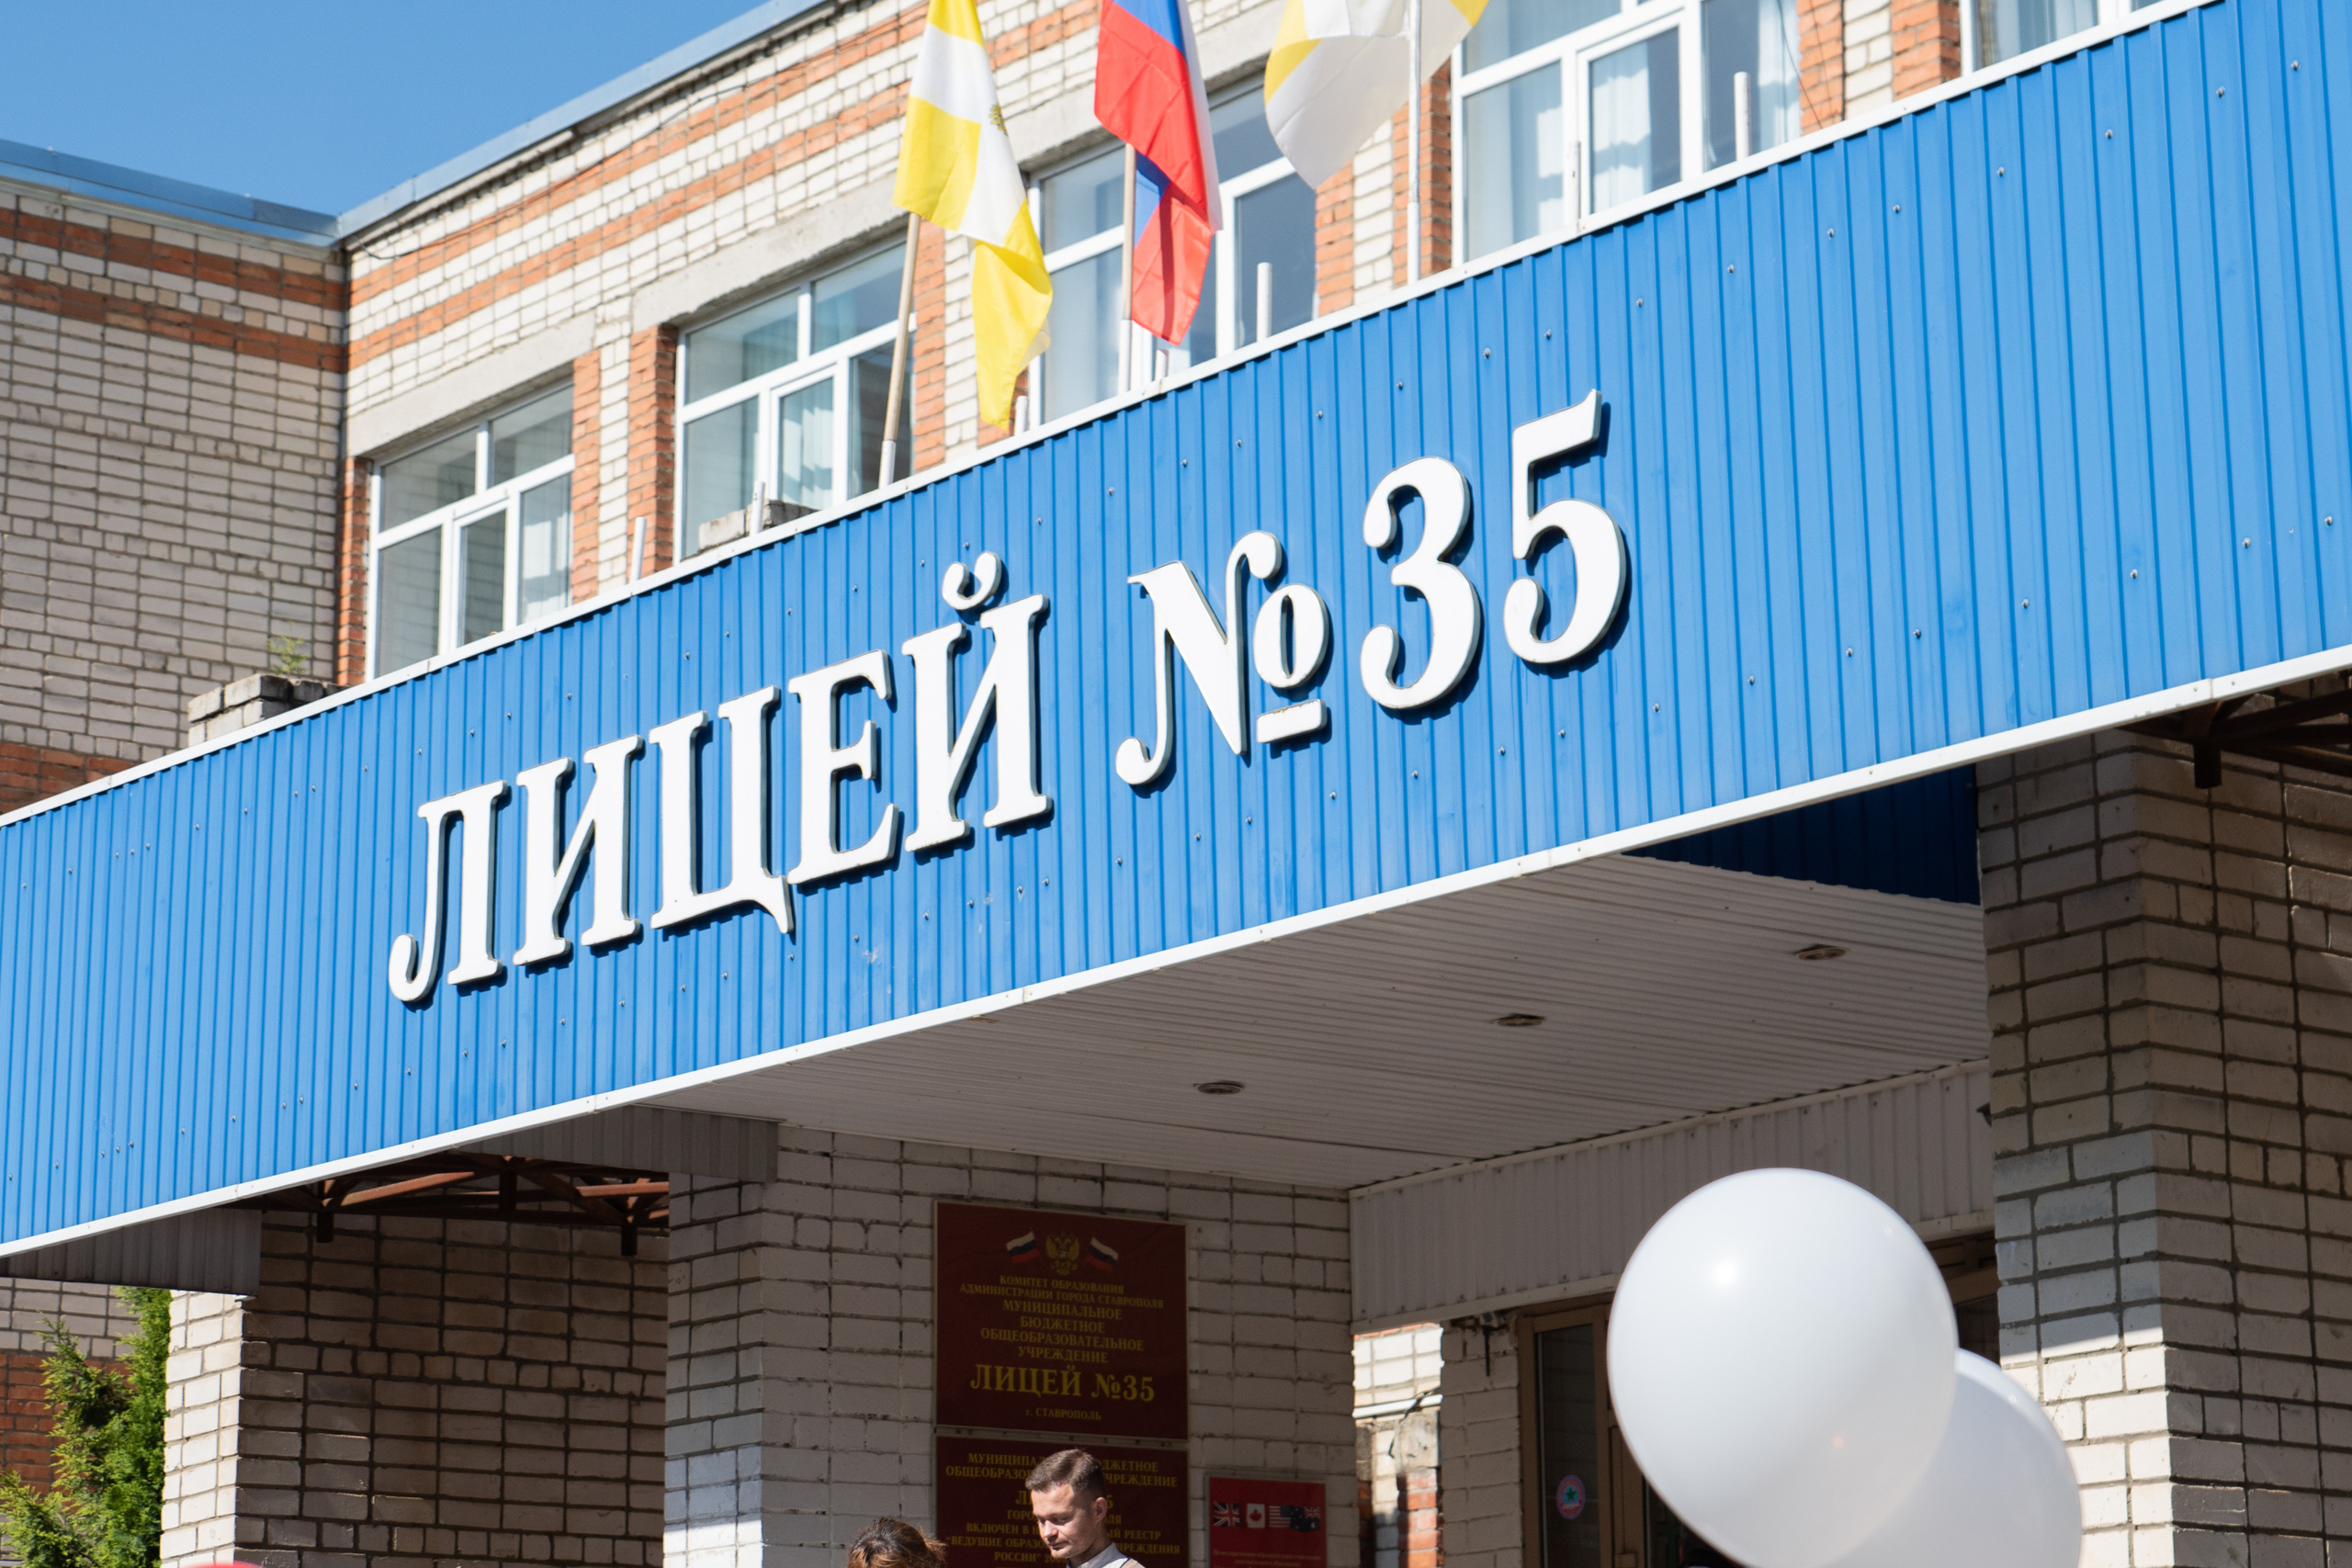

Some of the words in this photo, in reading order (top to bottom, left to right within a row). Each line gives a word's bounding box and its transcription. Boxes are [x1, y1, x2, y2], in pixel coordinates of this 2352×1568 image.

[387, 551, 1051, 1003] ЛИЦЕЙ
[1000, 1275, 1048, 1288] КОМИТЕТ
[1051, 1279, 1125, 1294] ОБРАЗОВАНИЯ
[959, 1283, 1053, 1300] АДМИНИСТРАЦИИ
[1056, 1291, 1096, 1303] ГОРОДА
[1098, 1295, 1164, 1309] СТАВРОПОЛЯ
[1003, 1300, 1123, 1320] МУНИЦИПАЛЬНОЕ
[1020, 1316, 1105, 1334] БЮДЖЕТНОЕ
[980, 1327, 1144, 1351] ОБЩЕОБРАЗОВАТЕЛЬНОЕ
[1018, 1347, 1109, 1364] УЧРЕЖДЕНИЕ
[970, 1364, 1082, 1398] ЛИЦЕЙ
[1091, 1372, 1155, 1402] №35
[1035, 1407, 1102, 1421] СТАВРОПОЛЬ
[1104, 1472, 1178, 1487] ЧРЕЖДЕНИЕ
[1022, 1525, 1030, 1535] В
[1125, 1529, 1161, 1540] РЕЕСТР
[1116, 1542, 1181, 1554] ЧРЕЖДЕНИЯ
